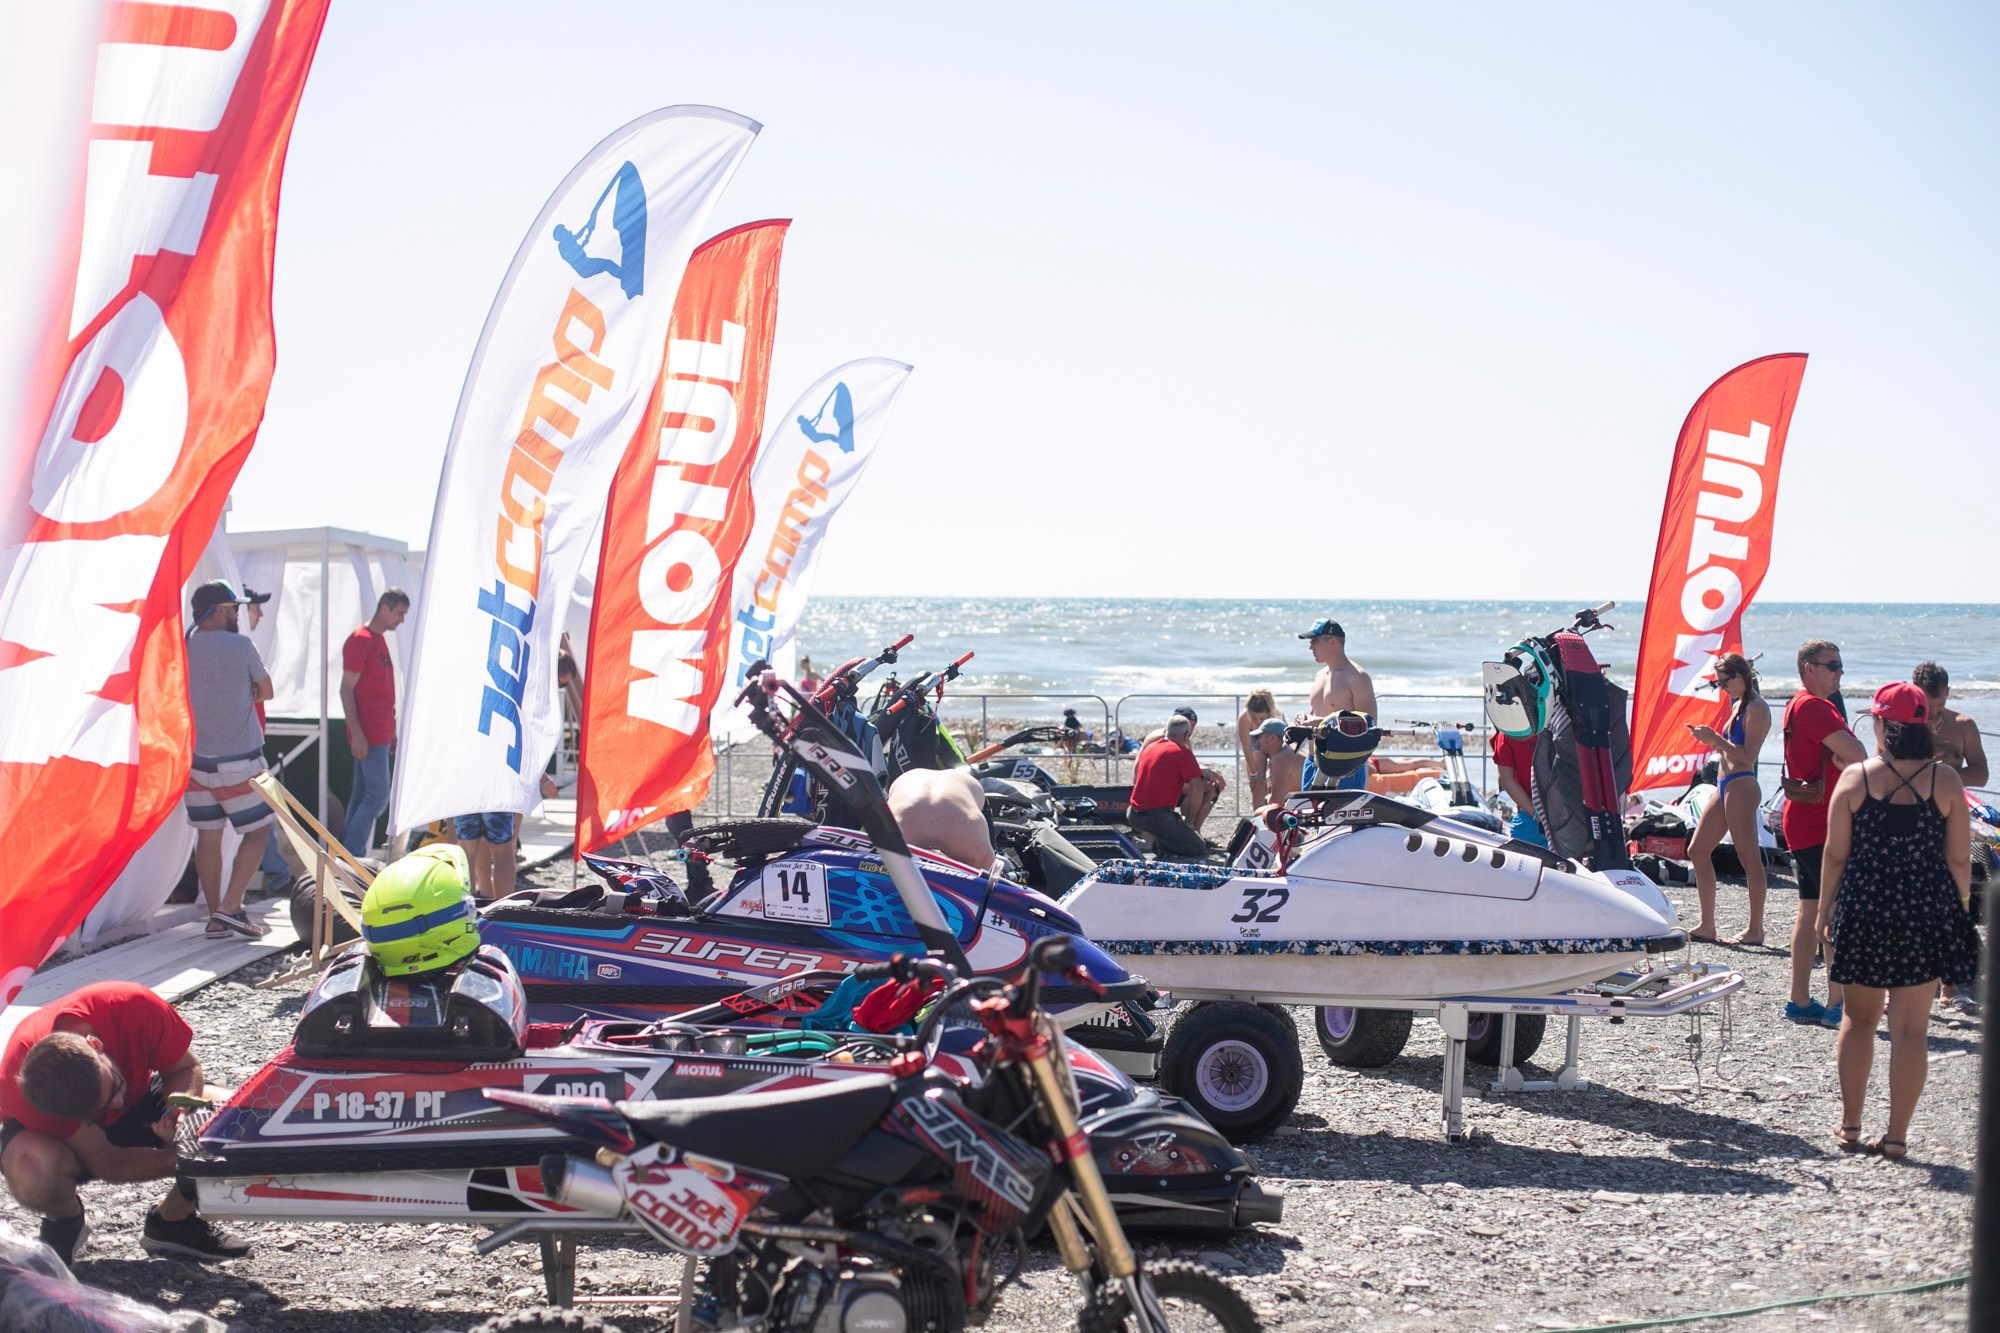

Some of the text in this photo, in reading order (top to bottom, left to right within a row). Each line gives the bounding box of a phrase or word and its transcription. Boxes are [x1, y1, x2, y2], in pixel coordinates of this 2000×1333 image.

[0, 0, 270, 767] MOTU
[627, 320, 746, 736] MOTUL
[1668, 420, 1771, 703] MOTUL
[1013, 765, 1036, 778] 55
[1645, 750, 1717, 776] MOTU
[763, 761, 788, 818] eRunner
[815, 832, 881, 854] SUP
[792, 862, 803, 870] Jet
[777, 870, 811, 904] 14
[1231, 888, 1290, 923] 32
[634, 933, 823, 973] SUPER
[676, 1065, 722, 1077] MOTUL
[335, 1092, 404, 1119] 18-37
